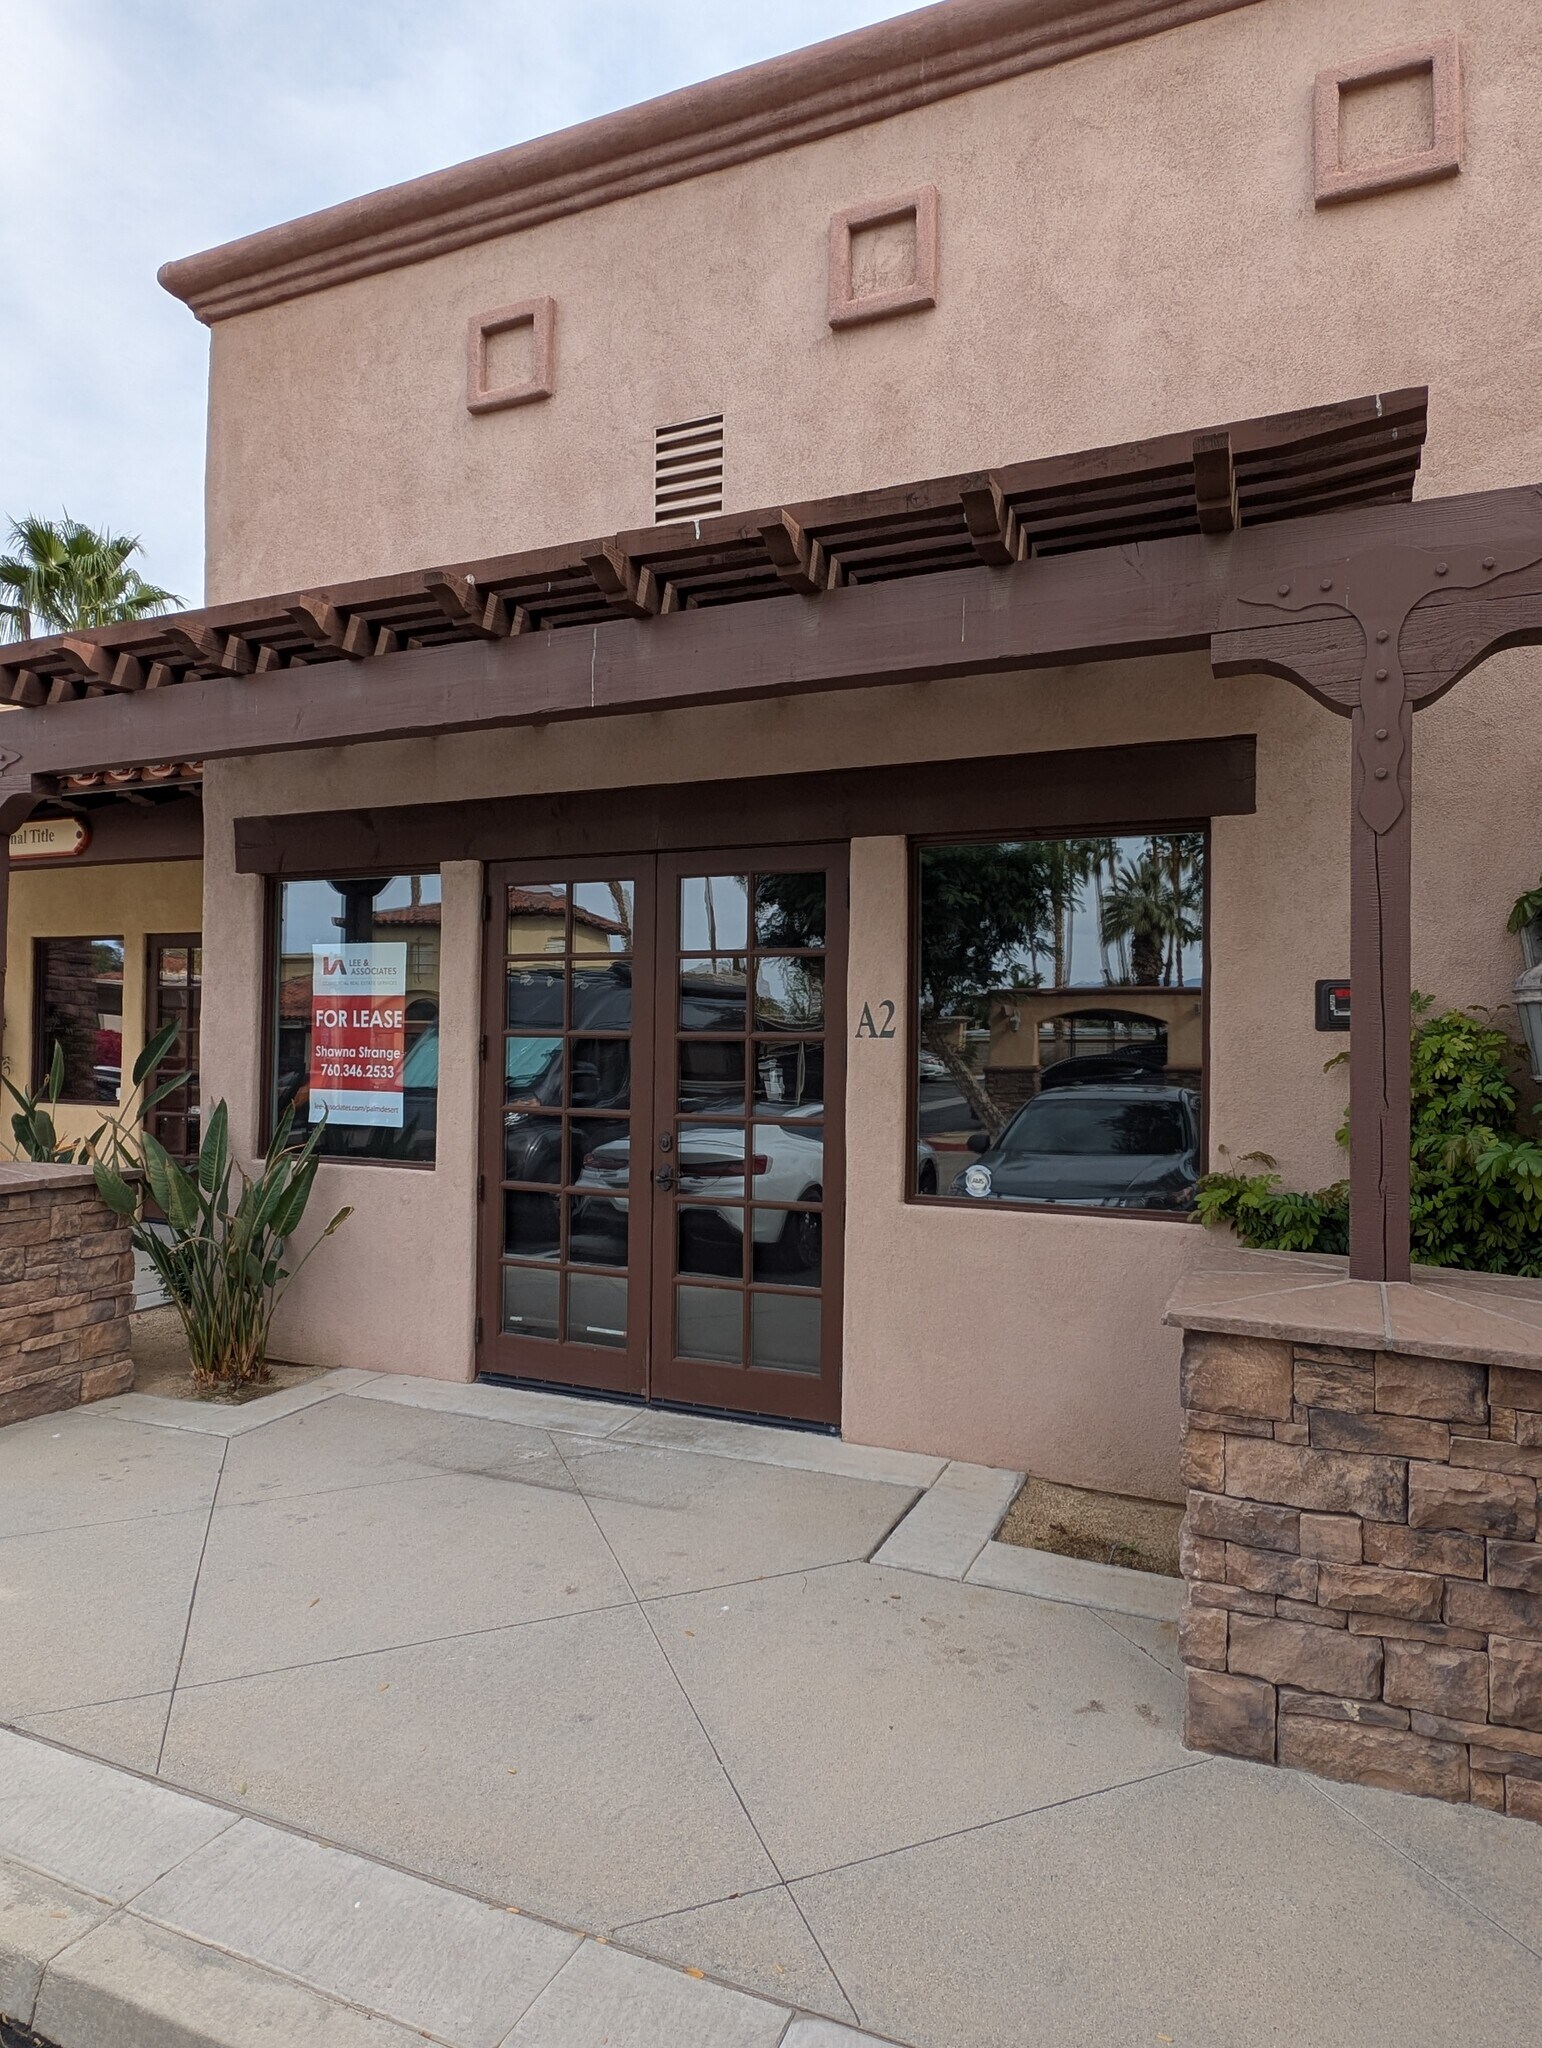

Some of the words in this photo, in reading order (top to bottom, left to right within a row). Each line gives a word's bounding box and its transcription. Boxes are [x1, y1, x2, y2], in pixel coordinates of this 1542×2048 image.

[10, 830, 27, 845] nal
[29, 828, 55, 843] Title
[349, 959, 361, 967] LEE
[363, 959, 369, 967] &
[351, 967, 397, 976] ASSOCIATES
[315, 1009, 348, 1028] FOR
[352, 1009, 403, 1029] LEASE
[854, 999, 897, 1039] A2
[315, 1045, 356, 1058] Shawna
[358, 1045, 401, 1062] Strange
[320, 1064, 395, 1079] 760.346.2533
[314, 1102, 399, 1114] lee-ssociates.com/palmdesert
